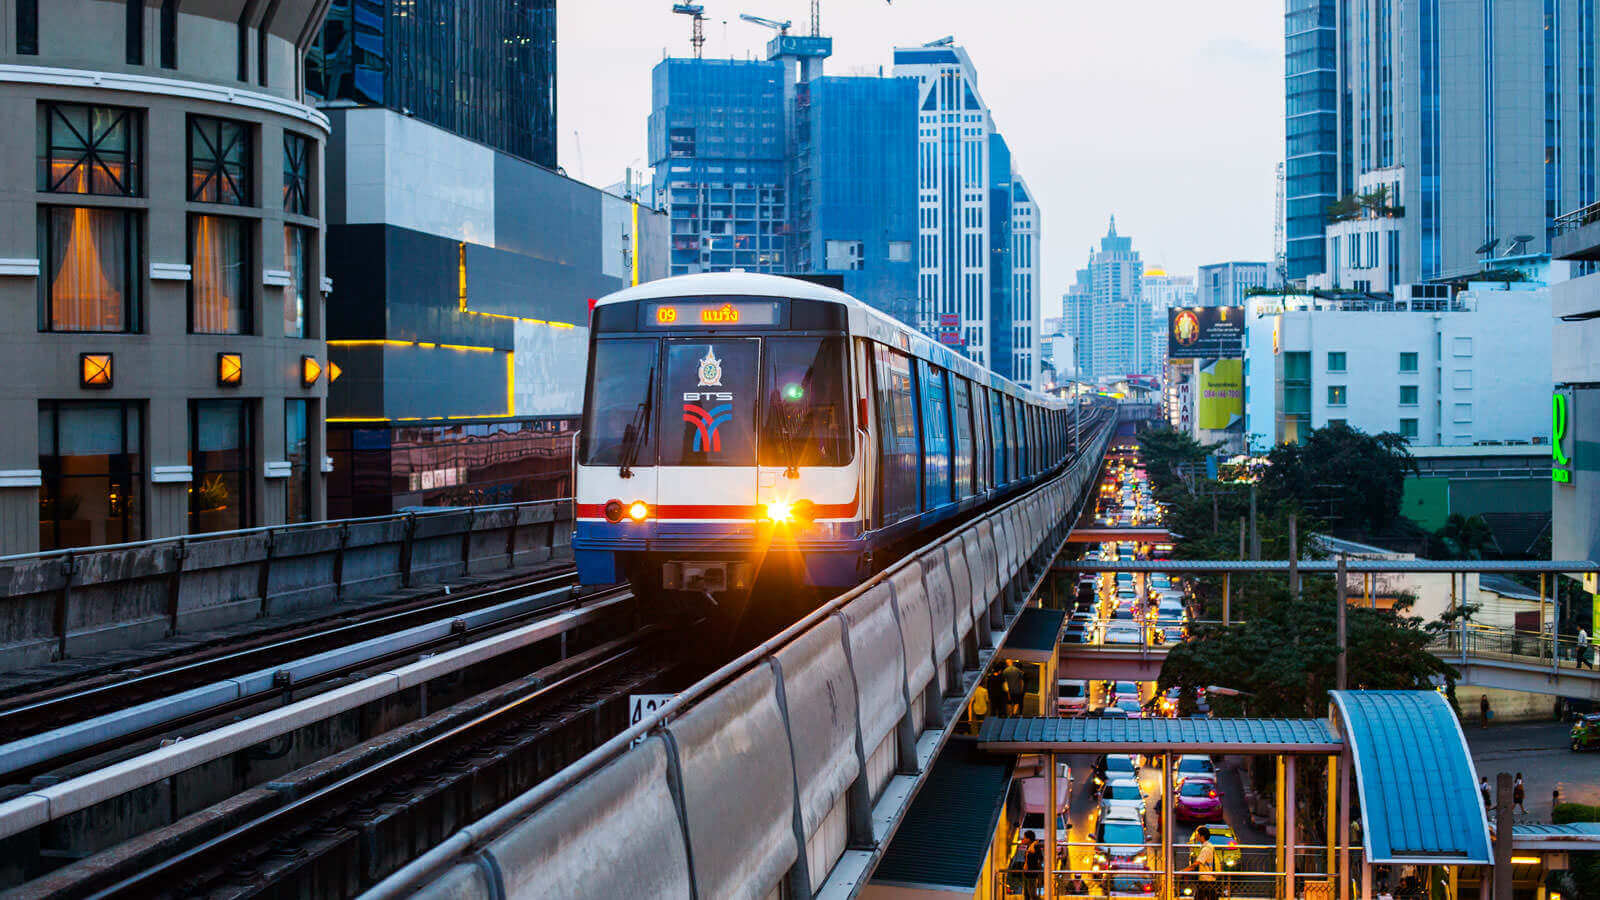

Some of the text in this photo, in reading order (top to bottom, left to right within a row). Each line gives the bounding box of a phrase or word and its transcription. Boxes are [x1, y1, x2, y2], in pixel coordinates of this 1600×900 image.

[658, 303, 739, 323] 09 แบริ่ง
[683, 392, 734, 401] BTS
[1181, 384, 1190, 432] MIAMI
